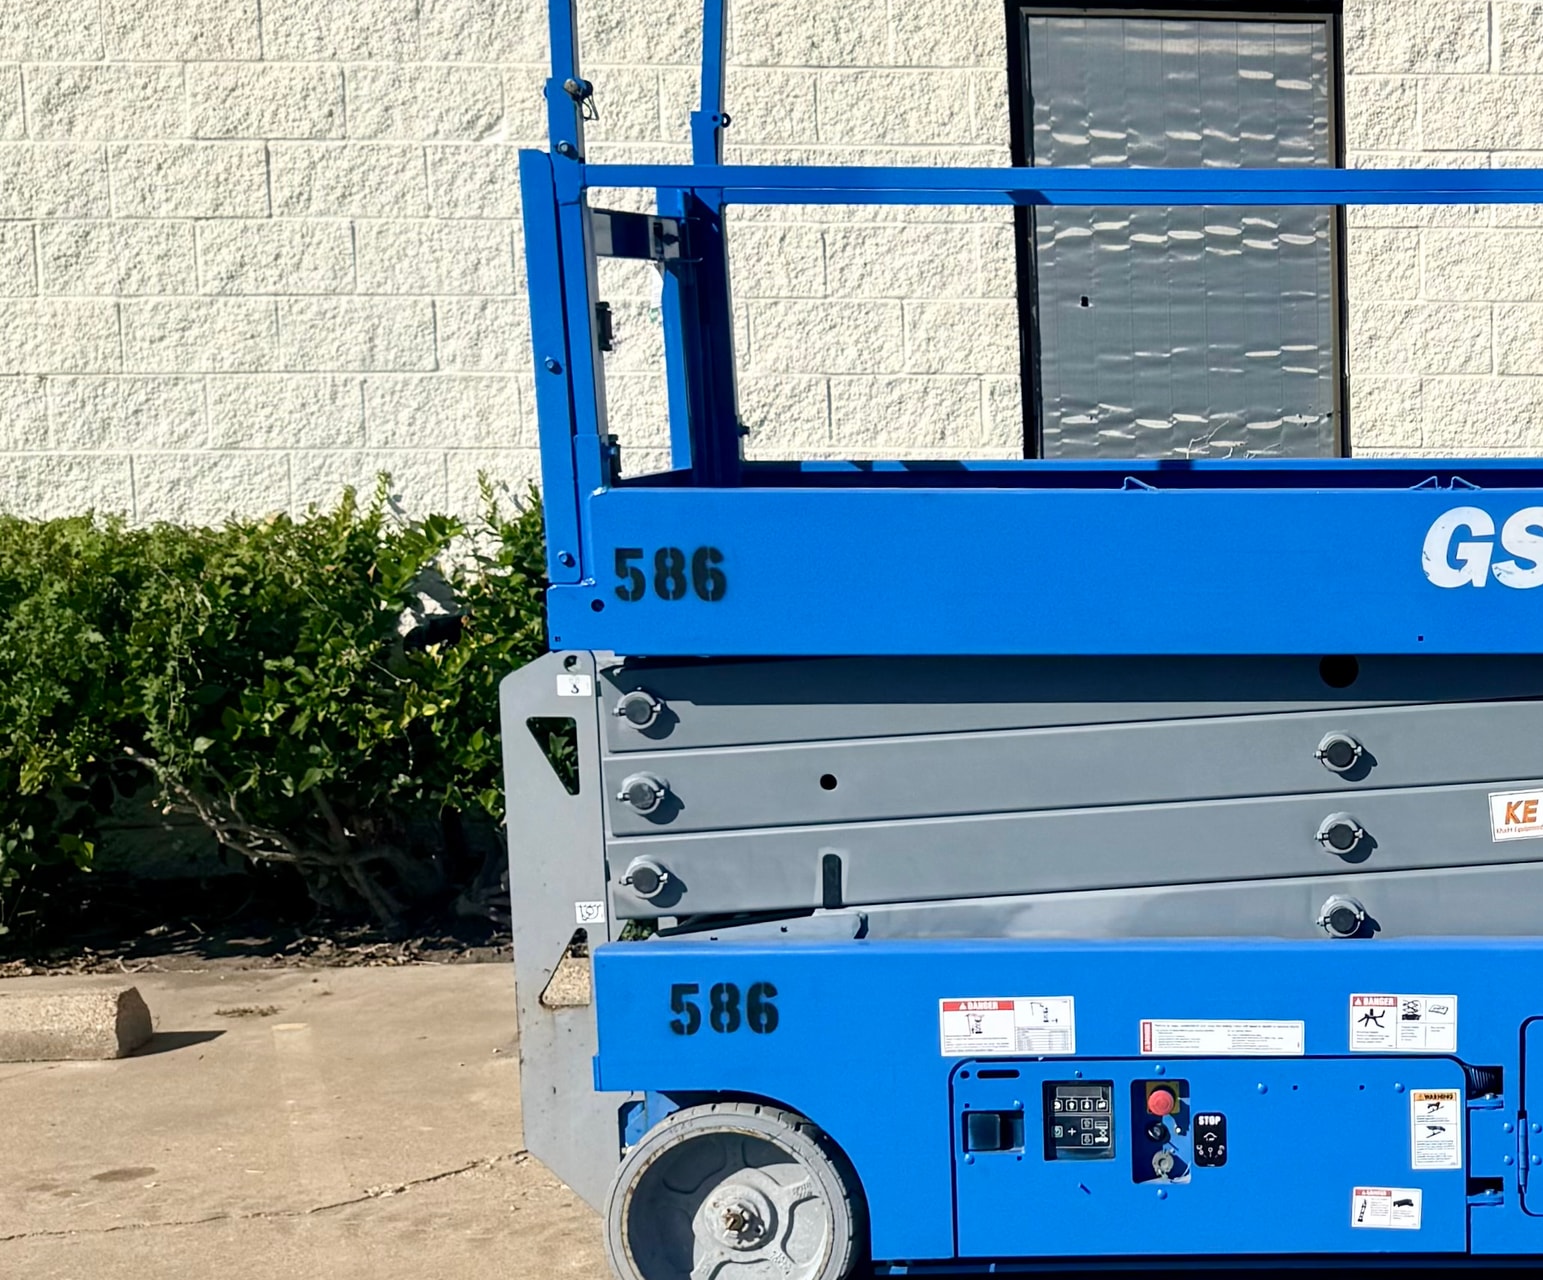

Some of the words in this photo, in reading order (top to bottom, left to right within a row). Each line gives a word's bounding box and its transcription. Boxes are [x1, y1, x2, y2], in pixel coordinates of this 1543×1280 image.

[614, 546, 727, 602] 586
[1504, 799, 1539, 825] KE
[670, 981, 779, 1035] 586
[1198, 1115, 1221, 1126] STOP
